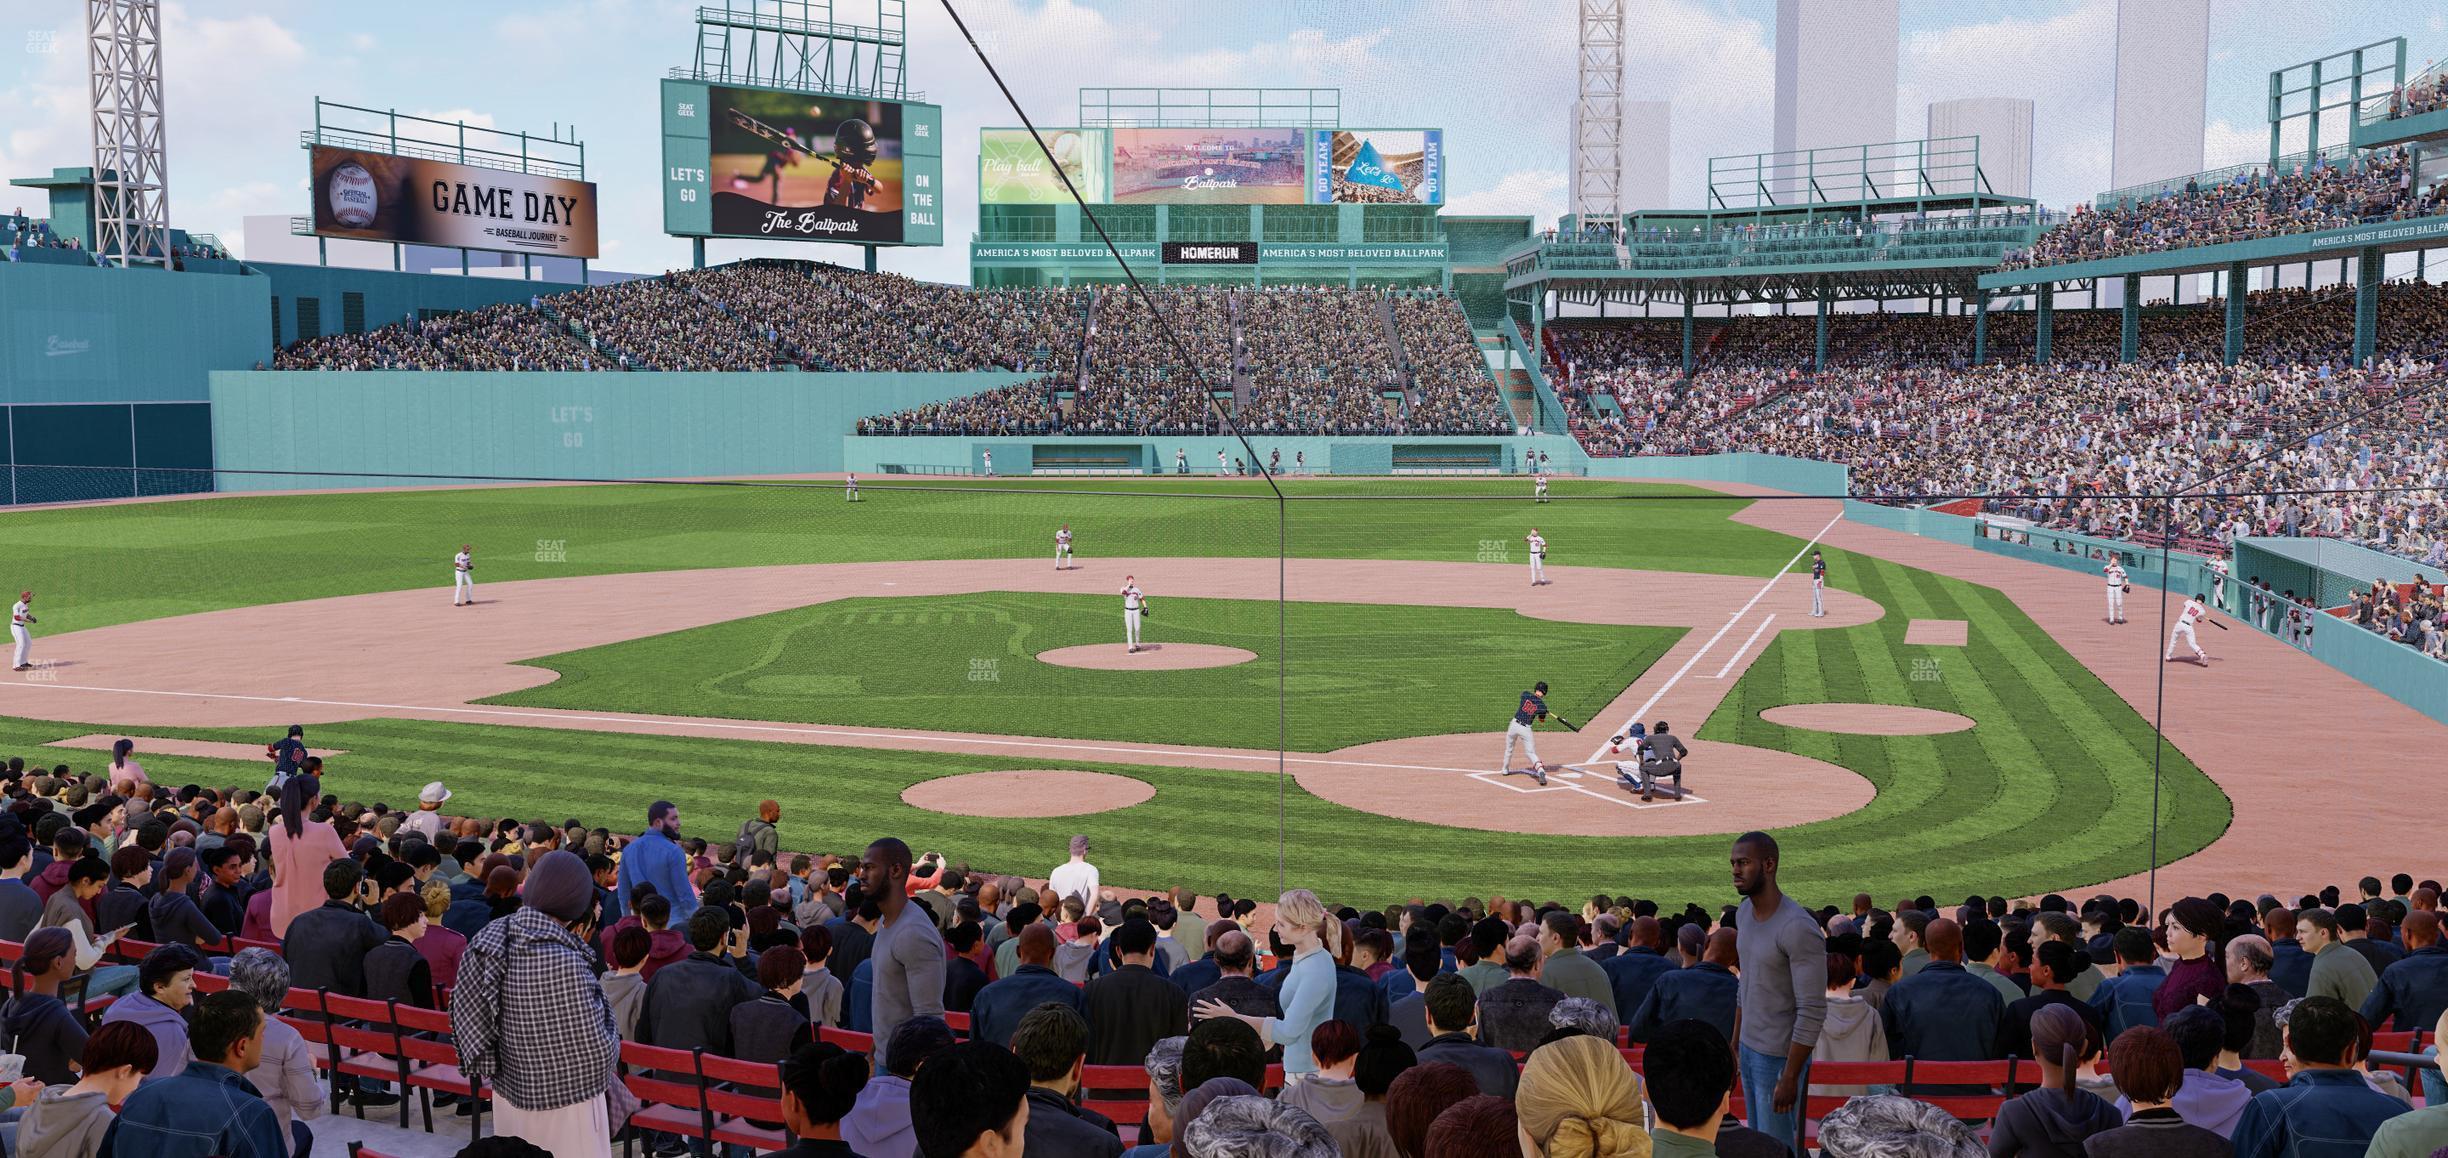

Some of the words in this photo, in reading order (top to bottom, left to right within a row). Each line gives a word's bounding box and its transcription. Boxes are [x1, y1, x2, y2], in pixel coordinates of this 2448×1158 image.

[1319, 142, 1328, 173] TEAM
[1428, 142, 1437, 173] TEAM
[671, 167, 705, 182] LET'S
[984, 158, 1013, 176] Play
[1016, 158, 1043, 172] ball
[915, 175, 929, 187] ON
[1182, 174, 1238, 191] Ballpark
[1318, 178, 1328, 193] GO
[1379, 174, 1395, 184] go
[1428, 178, 1437, 193] GO
[432, 179, 514, 220] GAME
[524, 191, 578, 226] DAY
[680, 188, 696, 202] GO
[913, 194, 933, 206] THE
[761, 210, 792, 233] The
[795, 211, 859, 234] Ballpark
[910, 212, 935, 225] BALL
[496, 228, 527, 239] BASEBALL
[529, 231, 557, 242] JOURNEY
[2312, 234, 2353, 247] AMERICA'S
[2354, 231, 2377, 242] MOST
[2378, 228, 2415, 239] BELOVED
[976, 248, 1029, 257] AMERICA'S
[1031, 249, 1058, 257] MOST
[1060, 249, 1103, 257] BELOVED
[1181, 246, 1239, 260] HOMERUN
[1262, 249, 1316, 257] AMERICA'S
[1318, 249, 1345, 257] MOST
[1348, 249, 1391, 257] BELOVED
[1393, 249, 1445, 257] BALLPARK
[551, 406, 593, 423] LET'S
[563, 432, 583, 448] GO
